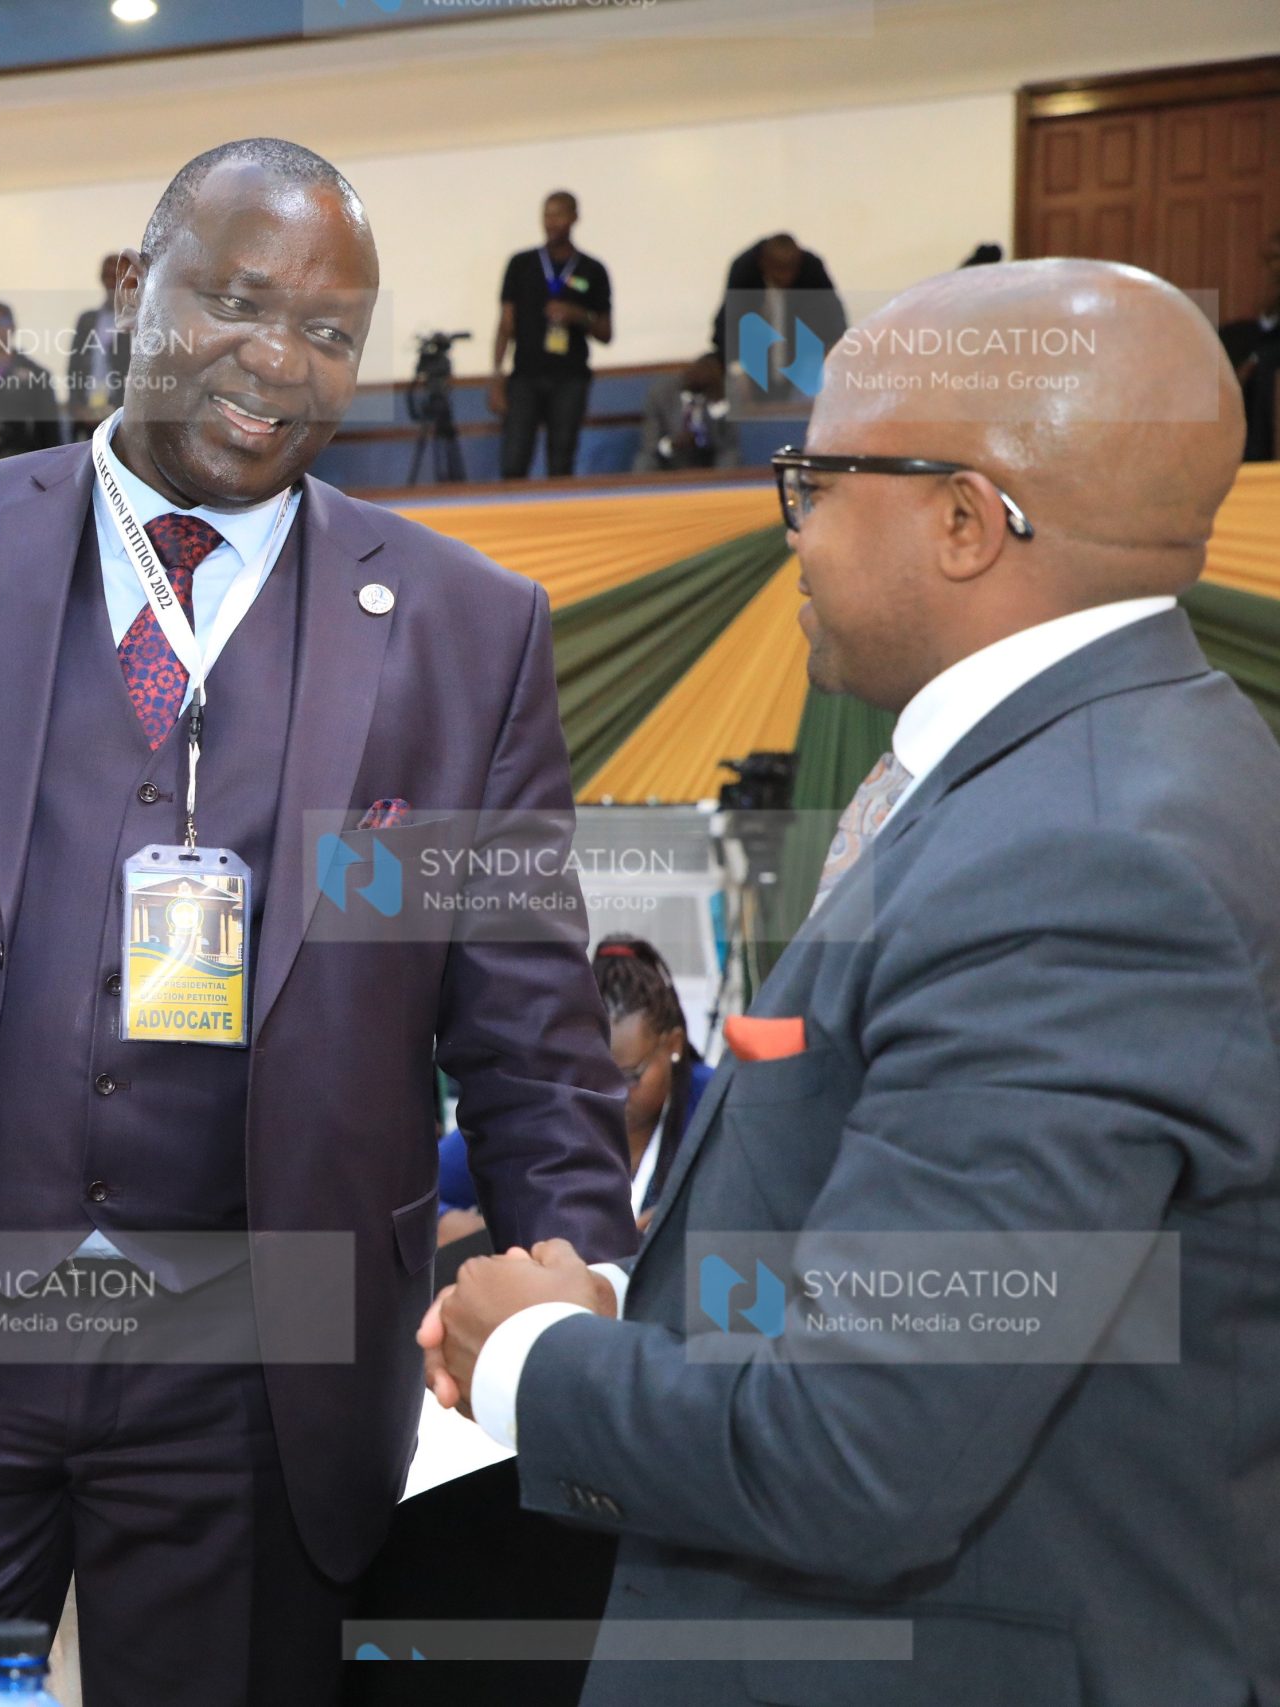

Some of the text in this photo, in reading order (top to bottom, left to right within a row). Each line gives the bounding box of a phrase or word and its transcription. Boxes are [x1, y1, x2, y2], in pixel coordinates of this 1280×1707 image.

[96, 452, 173, 610] ELECTION PETITION 2022
[186, 993, 227, 1002] PETITION
[136, 1009, 233, 1030] ADVOCATE
